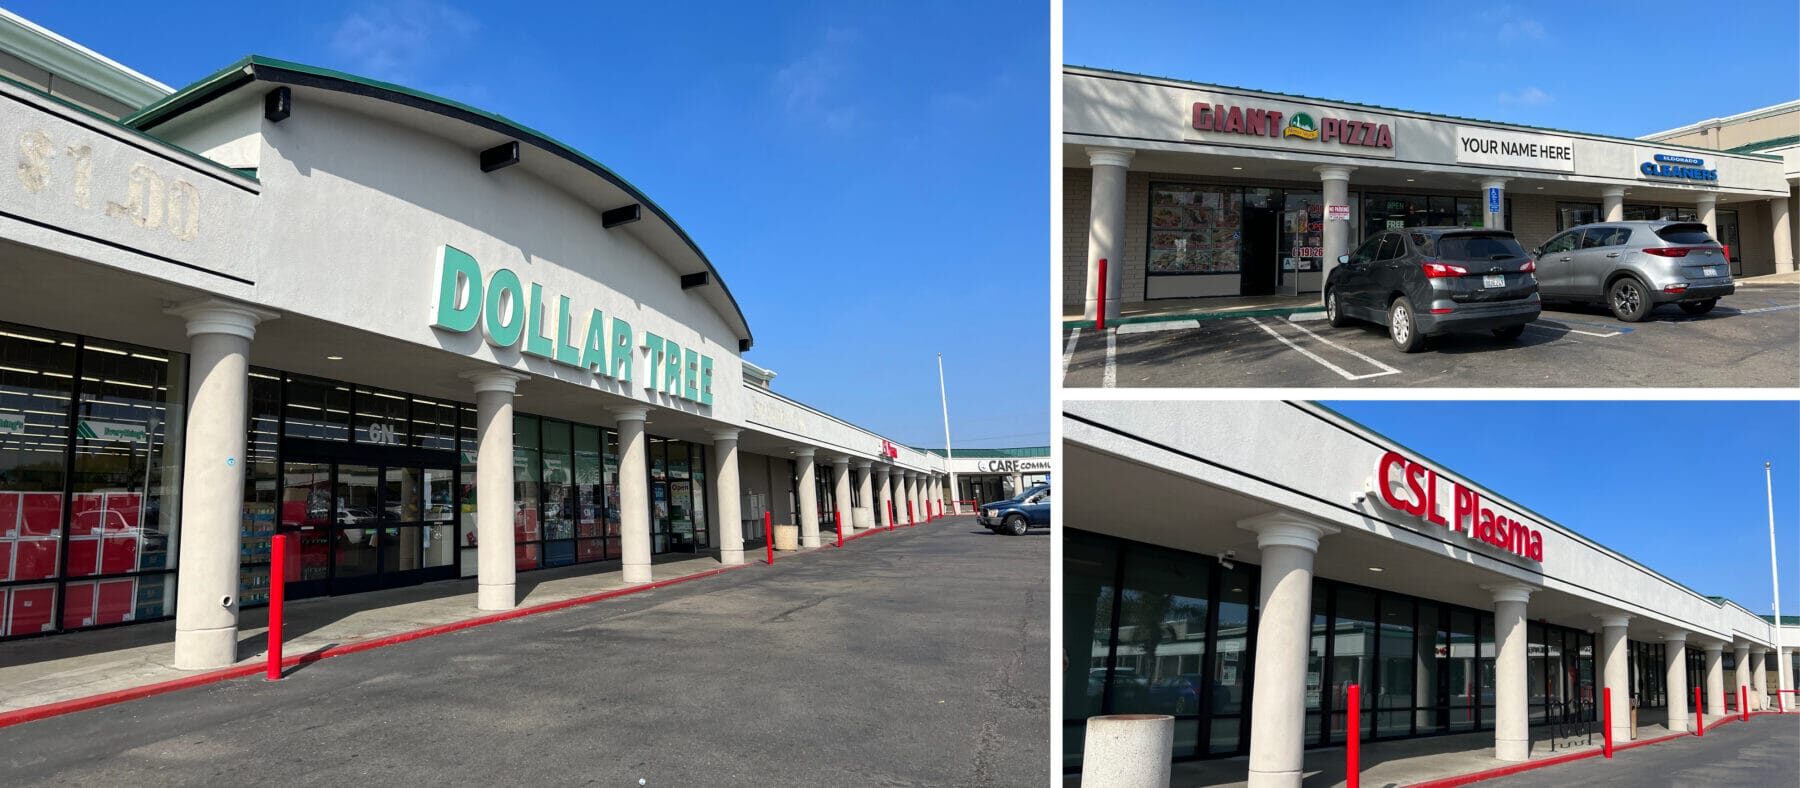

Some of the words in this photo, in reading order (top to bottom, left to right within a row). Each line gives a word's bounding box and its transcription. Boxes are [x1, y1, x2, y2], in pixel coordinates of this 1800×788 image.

[1192, 102, 1282, 138] GIANT
[1321, 117, 1393, 149] PIZZA
[1461, 137, 1498, 154] YOUR
[1501, 141, 1537, 157] NAME
[1540, 145, 1571, 160] HERE
[1640, 162, 1718, 181] CLEANERS
[1386, 220, 1405, 229] FREE
[430, 243, 634, 384] DOLLAR
[640, 331, 713, 406] TREE
[369, 422, 394, 445] 6N
[988, 460, 1020, 472] CARE
[1376, 451, 1446, 526] CSL
[1451, 481, 1543, 562] Plasma
